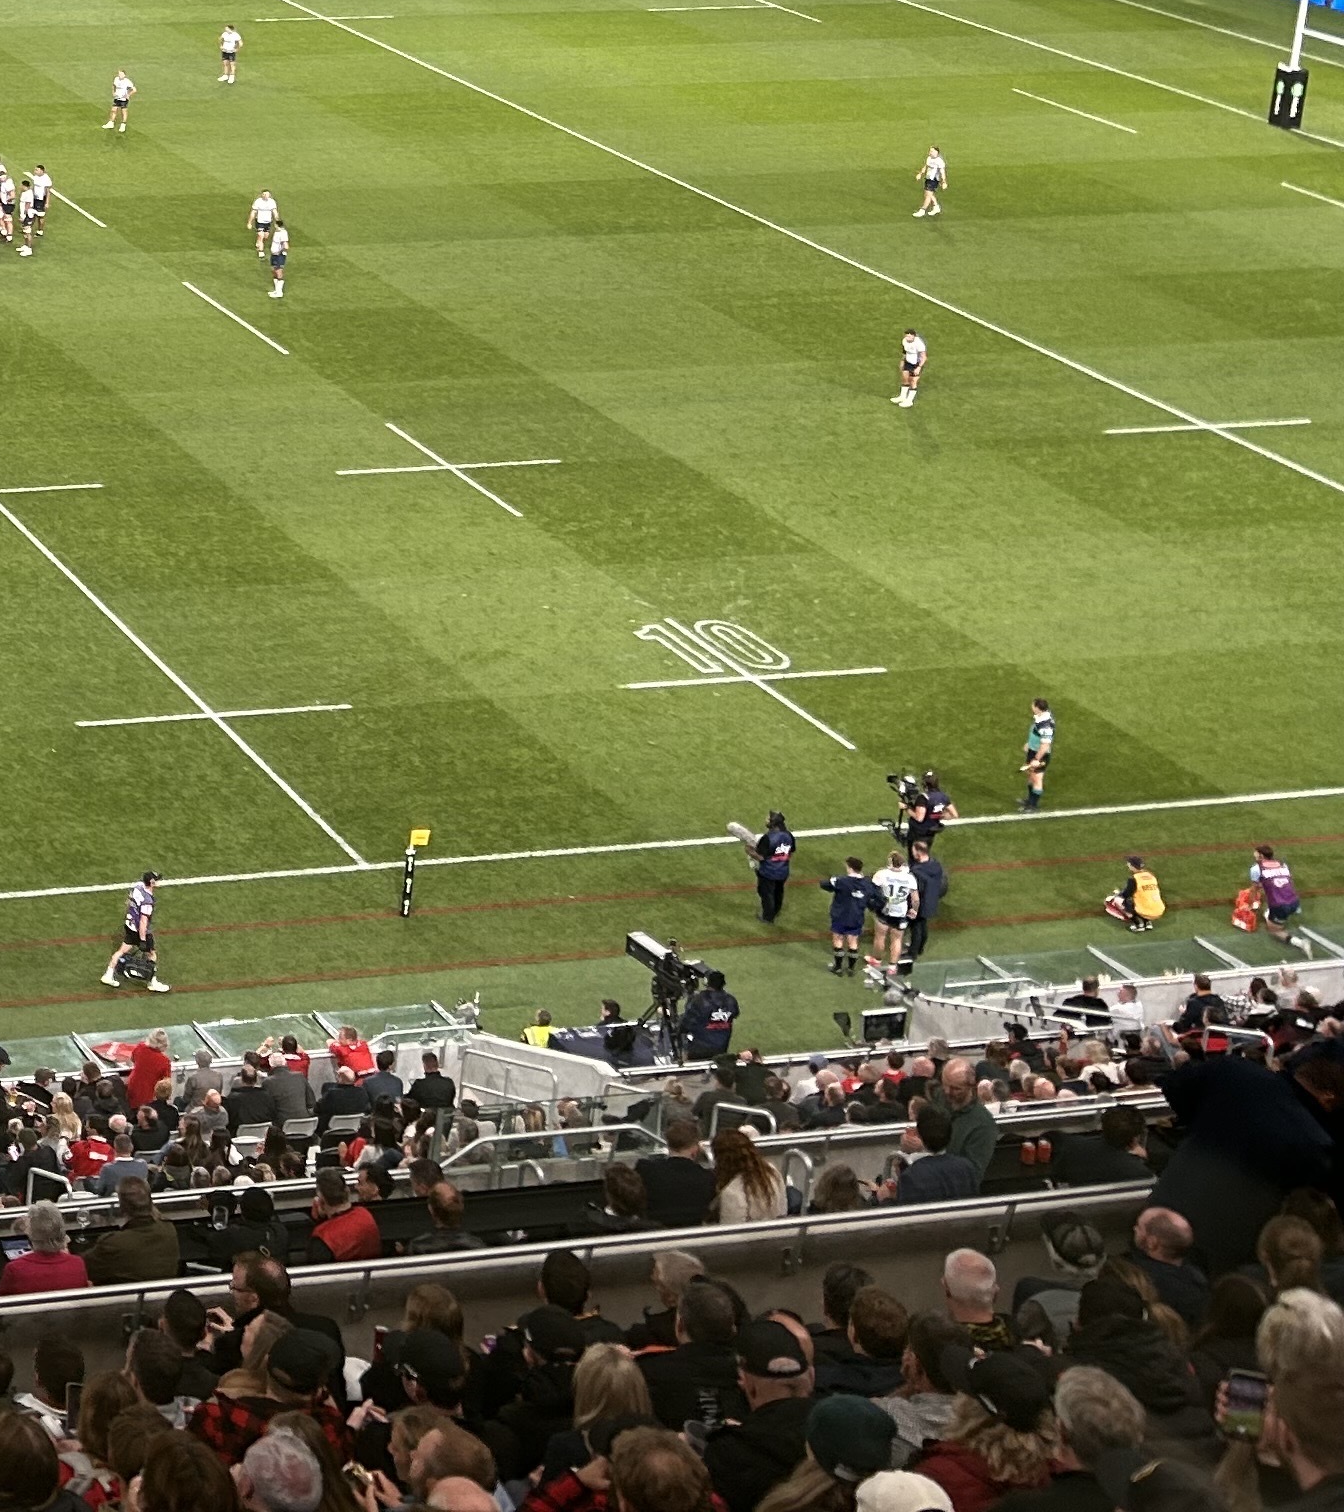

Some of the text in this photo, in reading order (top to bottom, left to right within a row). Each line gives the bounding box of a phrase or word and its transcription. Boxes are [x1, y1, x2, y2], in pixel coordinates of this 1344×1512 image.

[633, 619, 792, 674] 10
[887, 884, 909, 898] 15
[710, 1008, 732, 1022] sky
